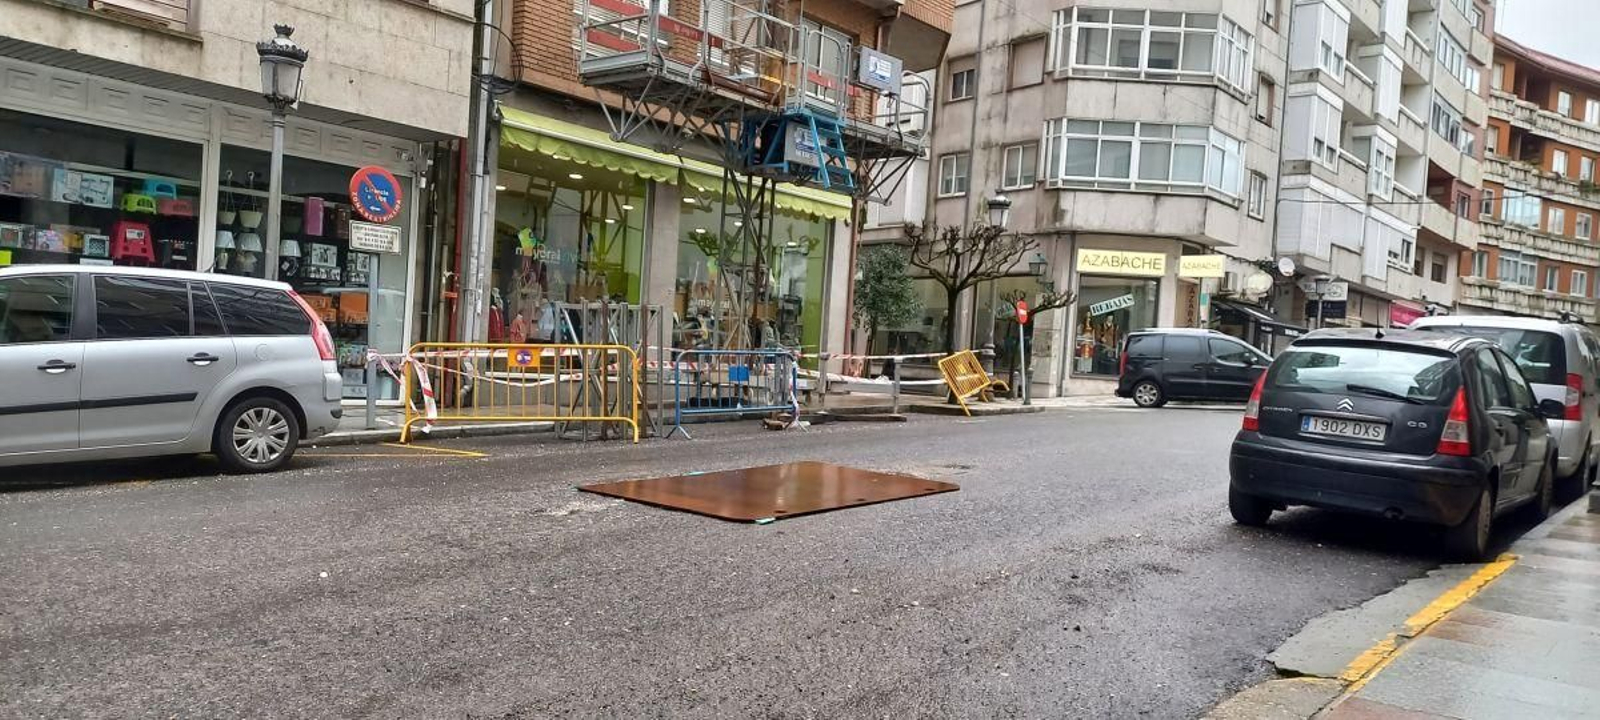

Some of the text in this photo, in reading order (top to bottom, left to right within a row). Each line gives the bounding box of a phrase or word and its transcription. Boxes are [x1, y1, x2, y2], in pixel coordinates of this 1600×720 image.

[1081, 254, 1163, 270] AZABACHE
[1181, 261, 1222, 270] AZABACHE
[1091, 294, 1134, 315] REBAJAS
[1187, 287, 1196, 328] AZABA
[1312, 418, 1348, 434] 1902
[1352, 422, 1382, 438] DXS
